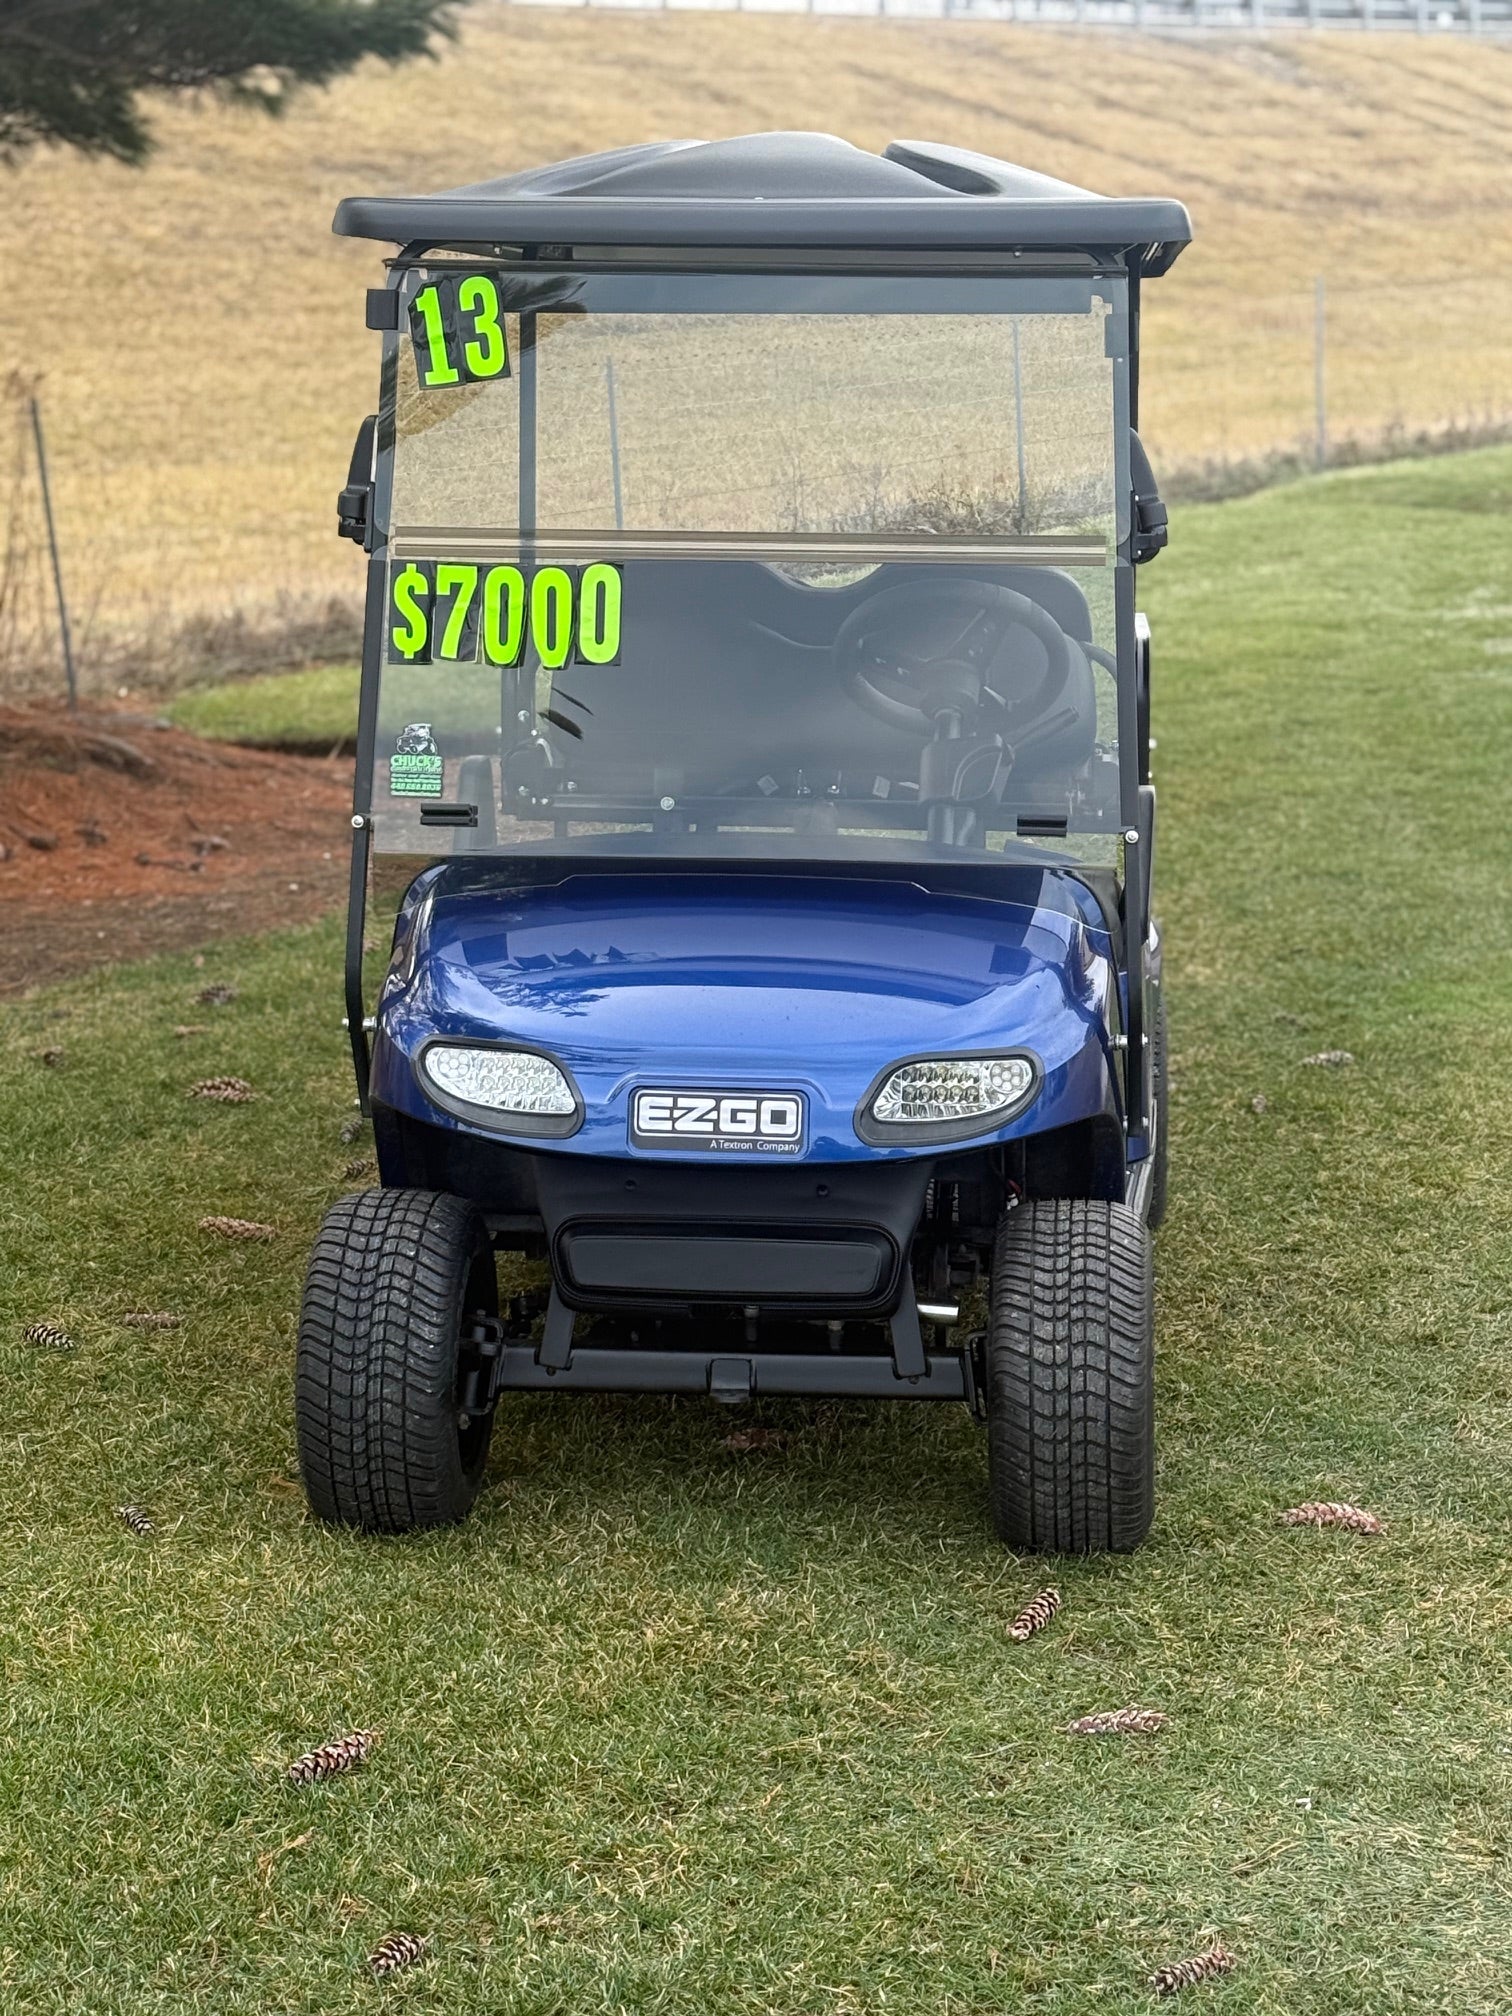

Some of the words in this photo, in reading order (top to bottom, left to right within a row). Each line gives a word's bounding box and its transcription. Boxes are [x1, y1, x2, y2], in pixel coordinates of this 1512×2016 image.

[415, 276, 506, 386] 13
[392, 563, 622, 669] $7000
[390, 755, 443, 768] CHUCK'S
[638, 1096, 798, 1135] EZGO
[710, 1140, 718, 1149] A
[719, 1140, 753, 1150] Textron
[757, 1141, 800, 1153] Company
